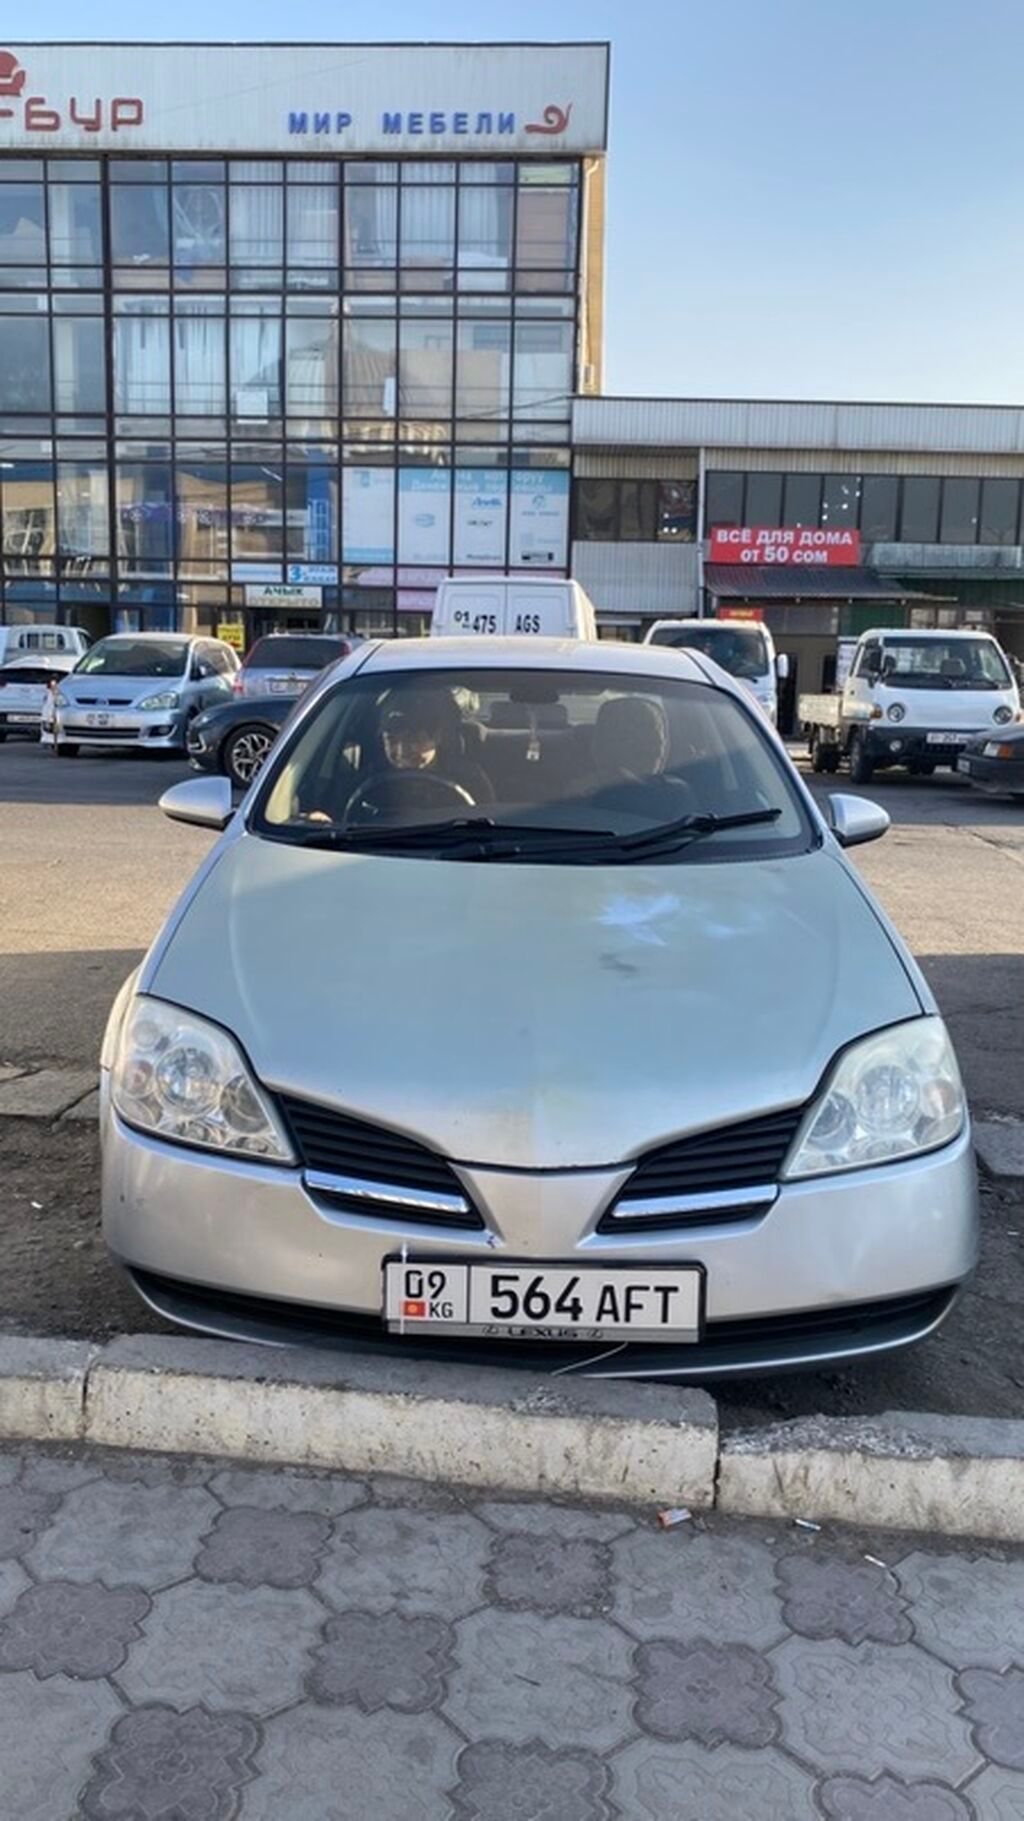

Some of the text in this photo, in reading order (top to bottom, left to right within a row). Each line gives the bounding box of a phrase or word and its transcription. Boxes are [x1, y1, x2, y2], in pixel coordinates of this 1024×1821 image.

[0, 97, 143, 131] БУР
[288, 112, 516, 135] МИР МЕБЕЛИ
[756, 530, 795, 545] ДЛЯ
[799, 531, 853, 546] ДОМА
[764, 546, 789, 563] 50
[472, 614, 497, 634] 475
[514, 614, 541, 634] AGS
[404, 1269, 679, 1324] 09 564 AFT
[428, 1301, 454, 1318] KG
[508, 1327, 578, 1338] LEXUS
